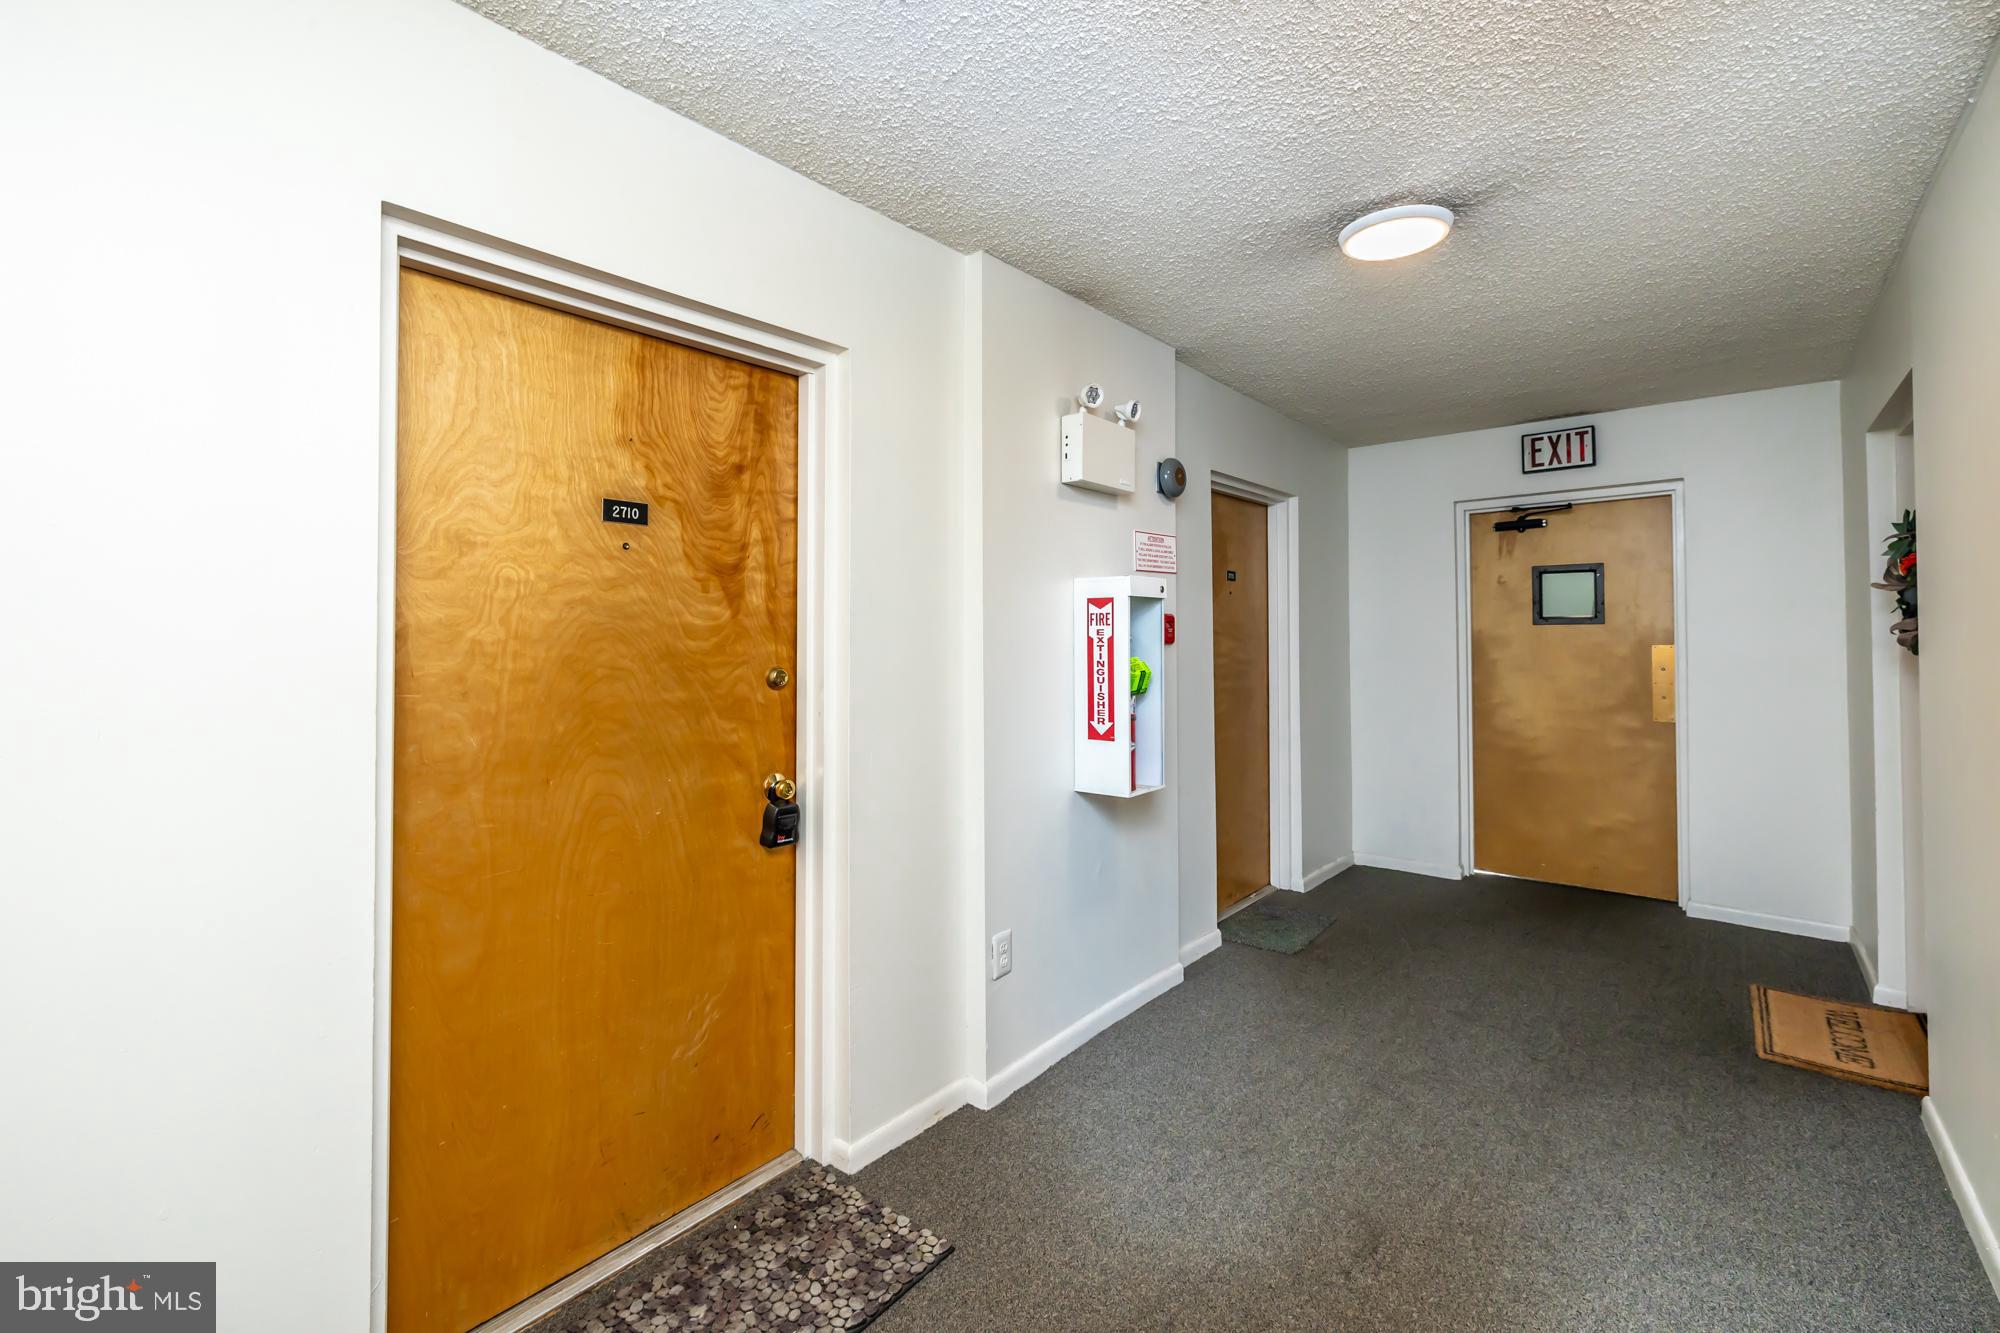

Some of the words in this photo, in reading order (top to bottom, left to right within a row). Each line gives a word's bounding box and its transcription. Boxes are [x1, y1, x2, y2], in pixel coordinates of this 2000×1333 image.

[1530, 430, 1589, 468] EXIT
[612, 505, 639, 520] 2710
[1089, 612, 1111, 627] FIRE
[1096, 628, 1106, 726] EXTINGUISHER
